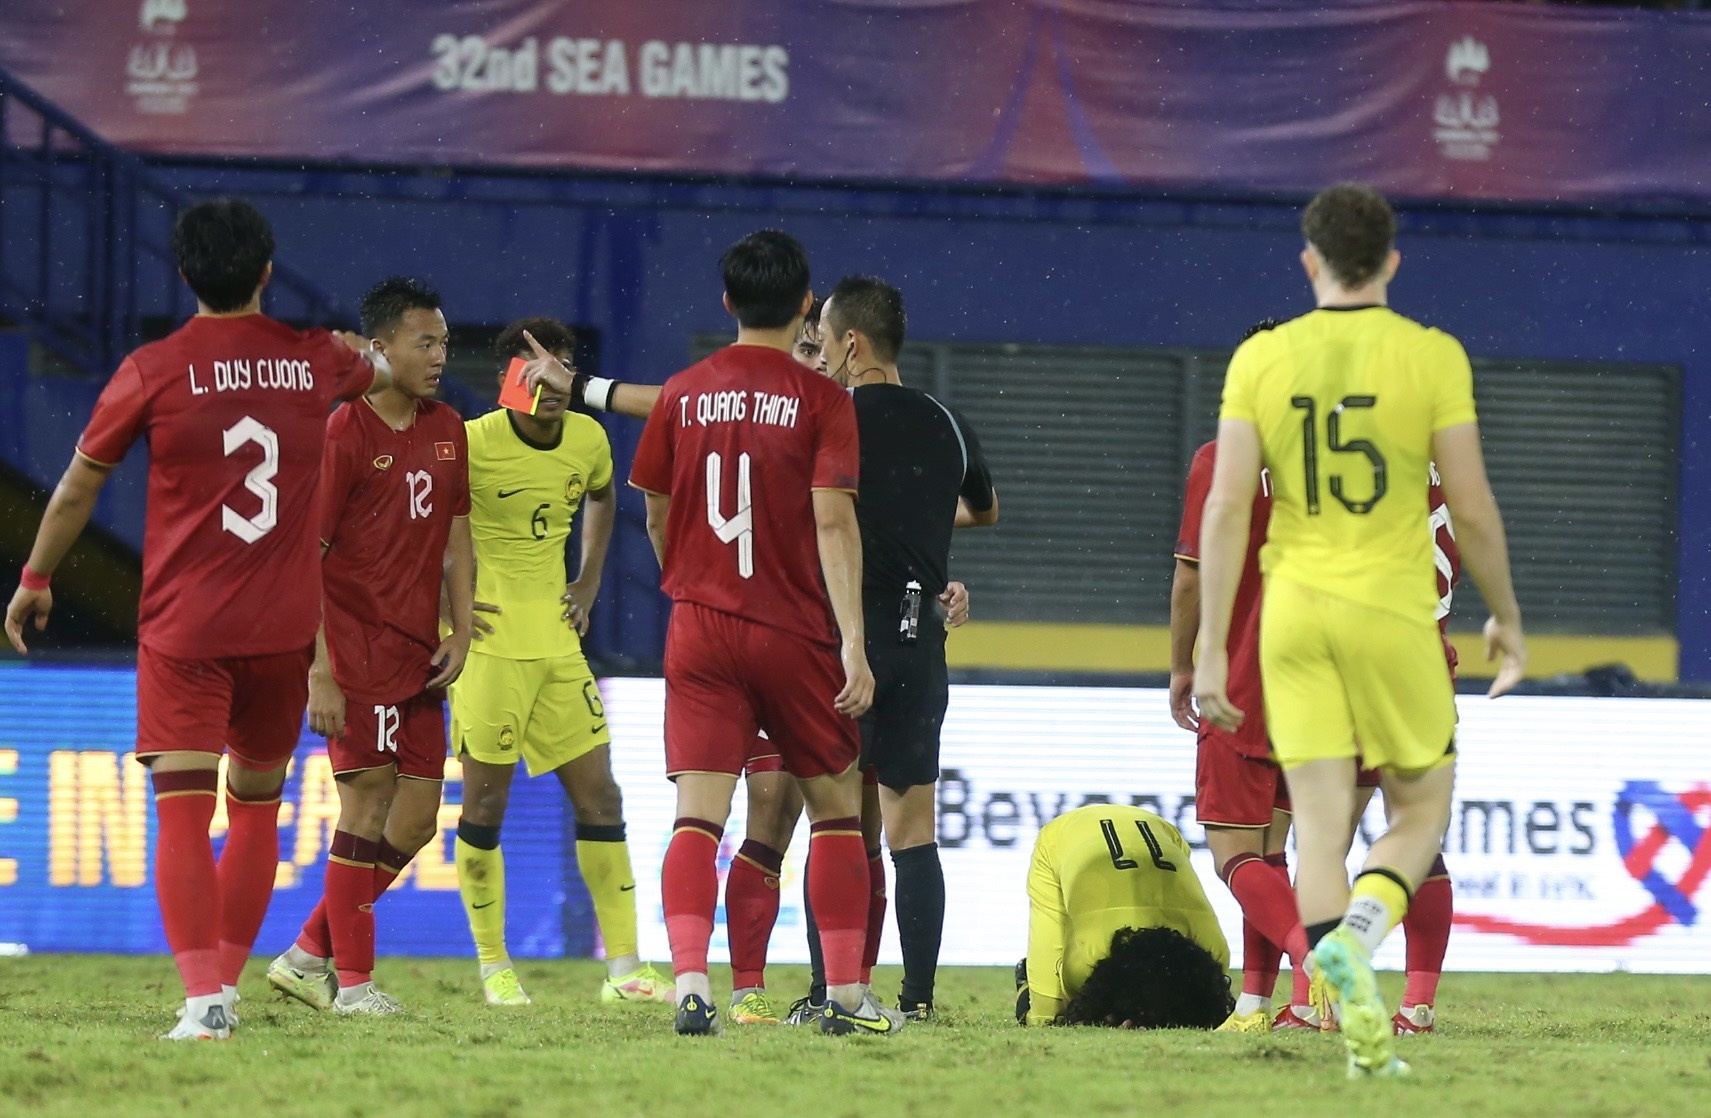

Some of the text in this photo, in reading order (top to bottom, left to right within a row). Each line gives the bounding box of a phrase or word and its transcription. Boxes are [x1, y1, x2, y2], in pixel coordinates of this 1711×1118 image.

[431, 34, 789, 102] 32nd SEA GAMES
[189, 358, 314, 395] L. DUY CUONG
[680, 389, 799, 428] T. QUANG THINH
[222, 415, 279, 544] 3
[1290, 395, 1387, 515] 15
[406, 469, 433, 520] 12
[706, 451, 754, 579] 4
[531, 503, 550, 540] 6
[582, 680, 604, 718] 6
[374, 704, 400, 753] 12
[50, 750, 147, 887] IN
